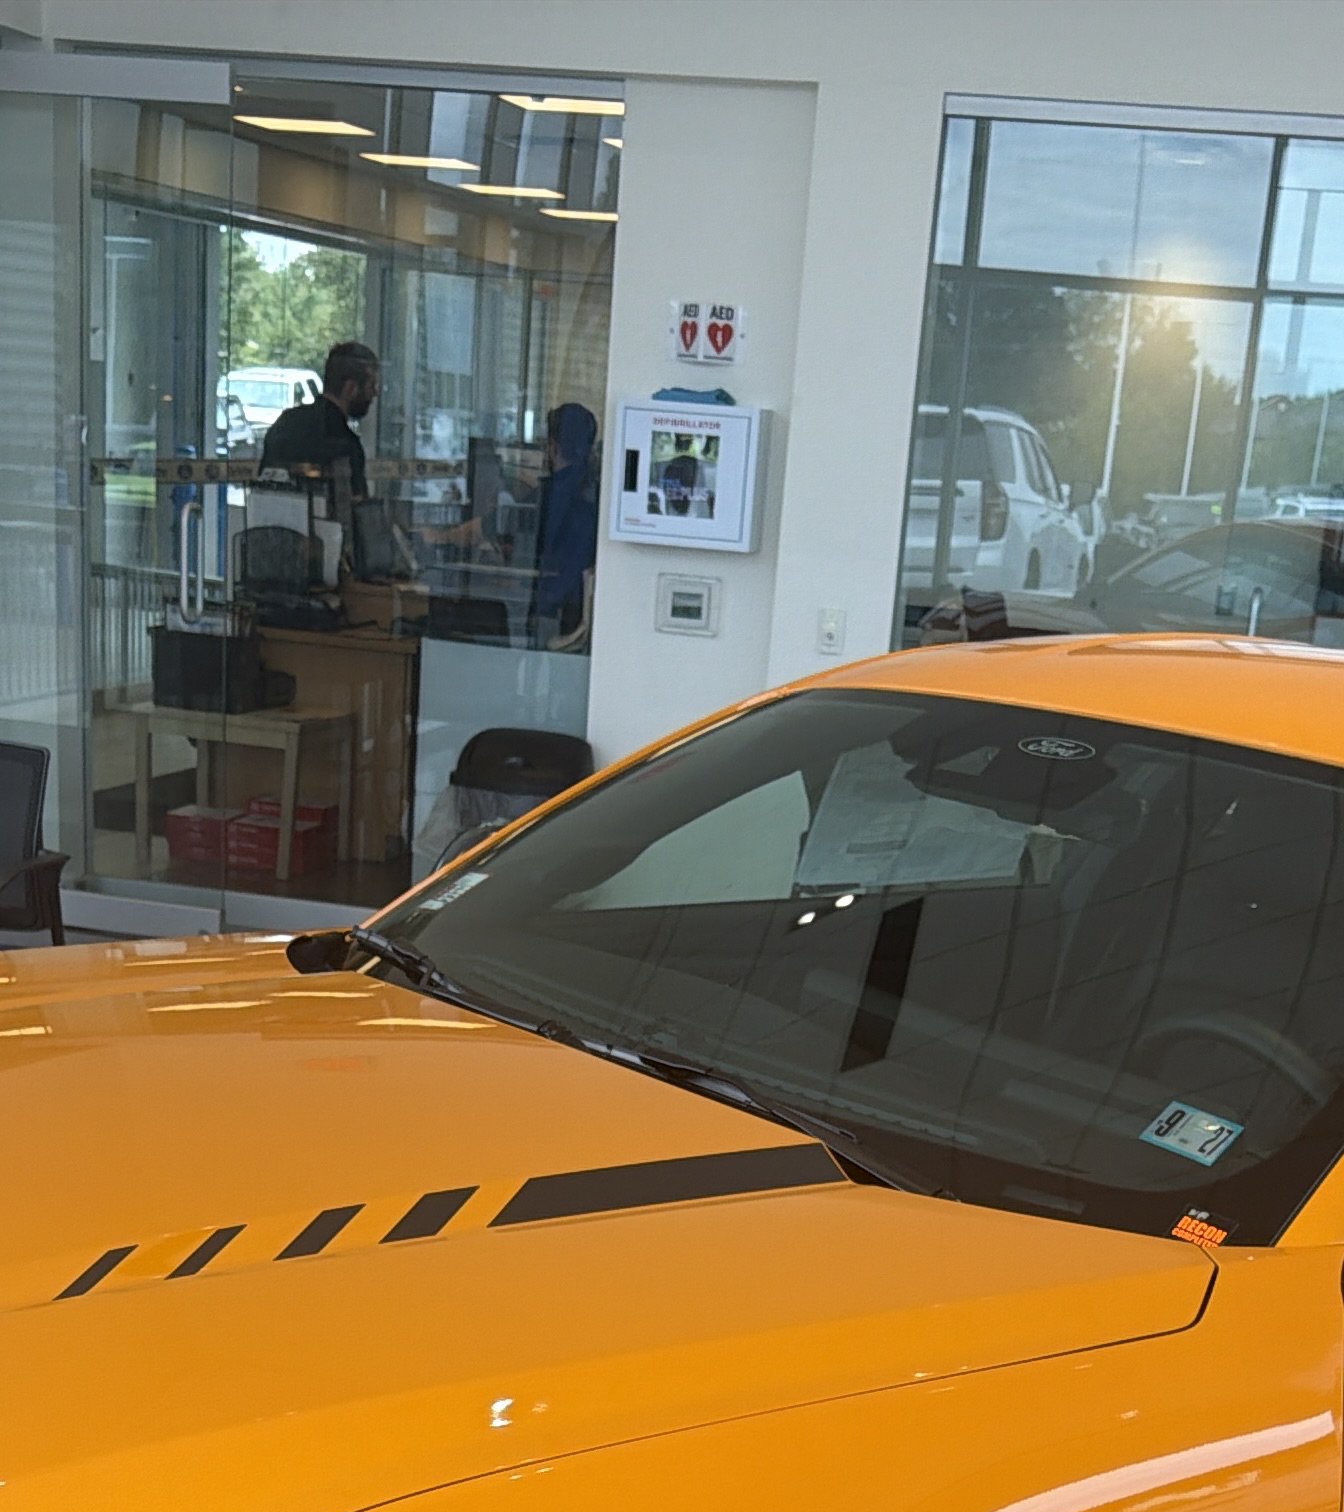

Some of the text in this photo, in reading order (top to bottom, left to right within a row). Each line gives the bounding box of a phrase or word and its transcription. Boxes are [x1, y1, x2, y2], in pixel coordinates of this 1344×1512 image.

[709, 304, 734, 321] AED
[1027, 740, 1084, 757] Ford
[1176, 1215, 1227, 1243] RECON
